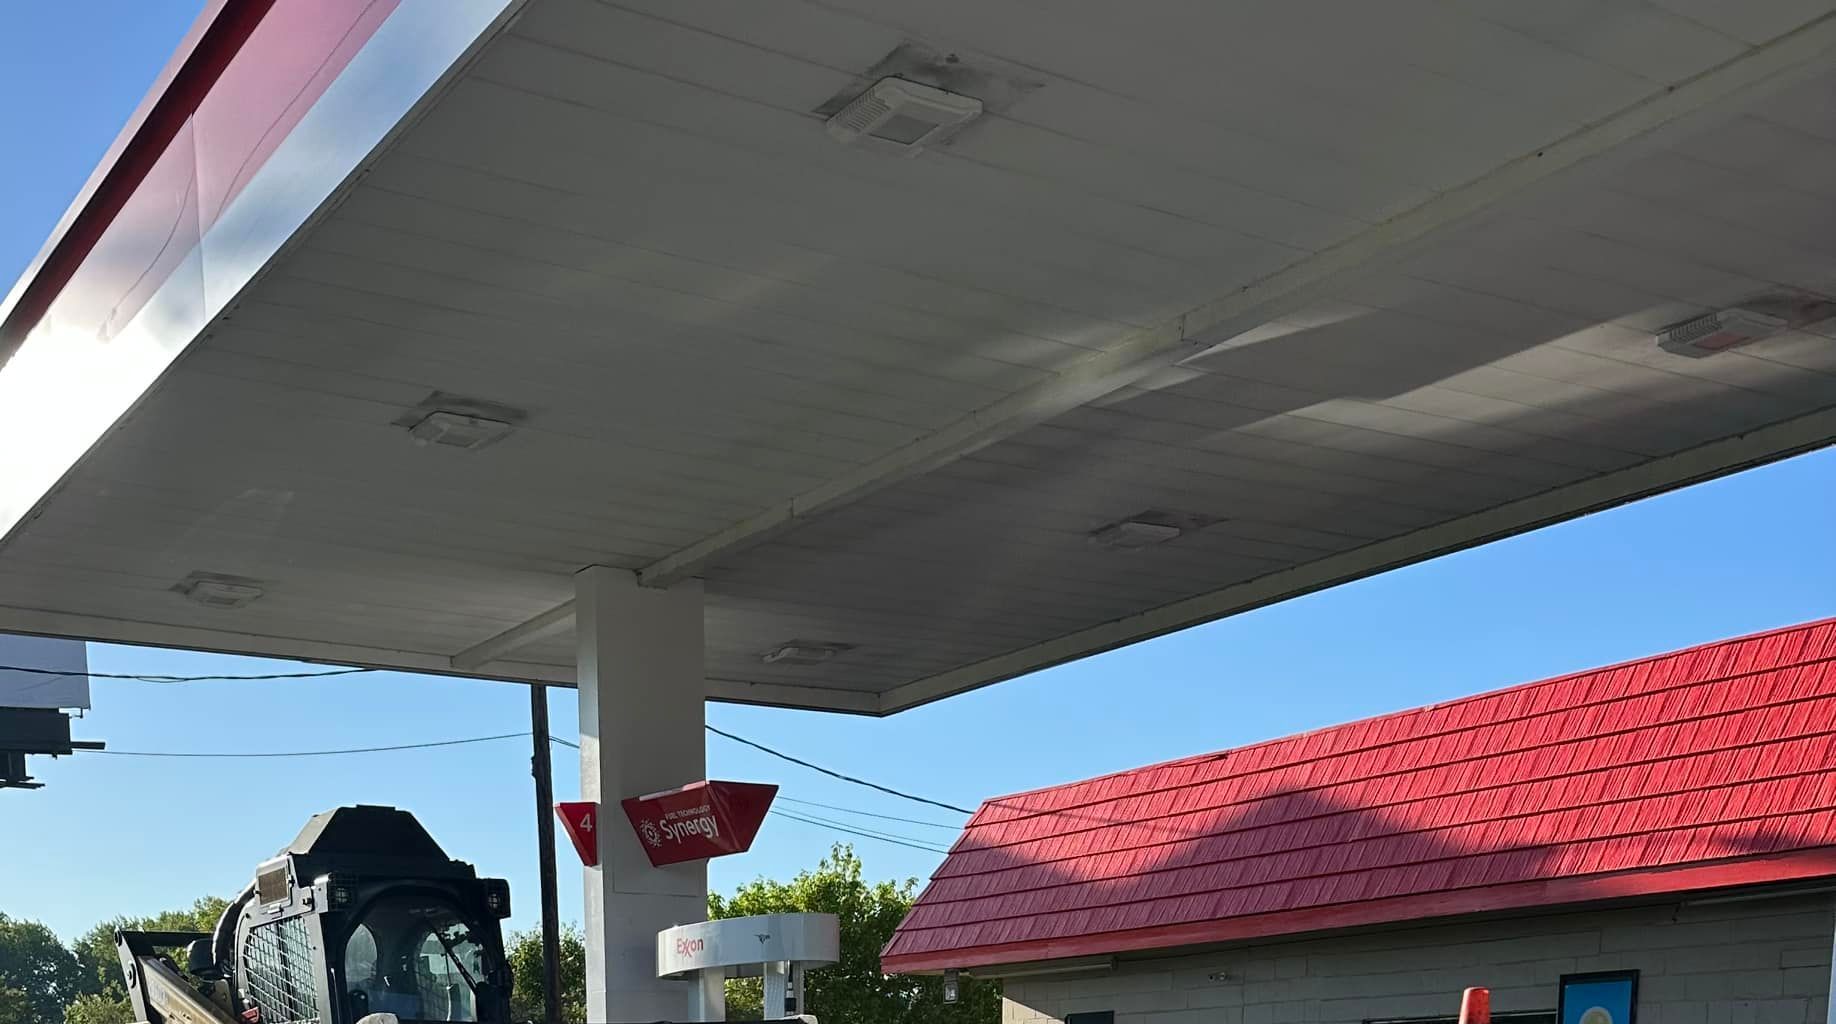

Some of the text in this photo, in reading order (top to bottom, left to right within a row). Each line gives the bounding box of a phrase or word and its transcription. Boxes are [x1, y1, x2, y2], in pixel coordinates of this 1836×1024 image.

[580, 813, 593, 832] 4
[660, 815, 719, 844] Synergy
[676, 937, 704, 958] Exxon
